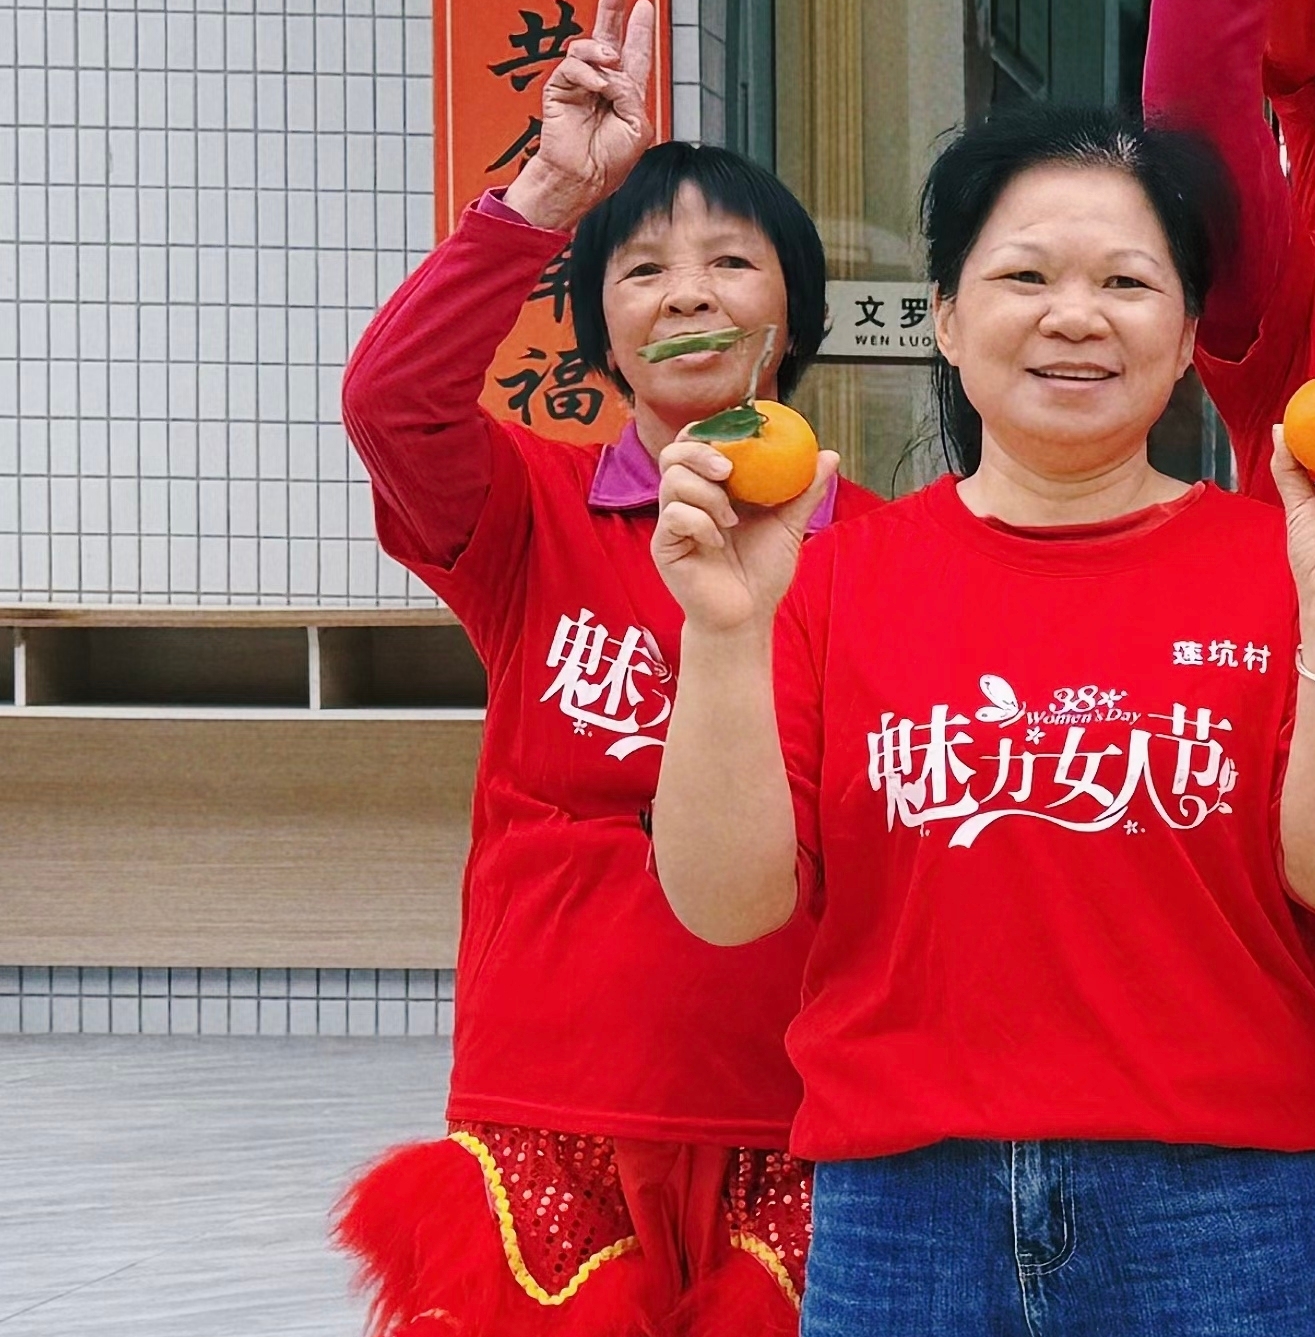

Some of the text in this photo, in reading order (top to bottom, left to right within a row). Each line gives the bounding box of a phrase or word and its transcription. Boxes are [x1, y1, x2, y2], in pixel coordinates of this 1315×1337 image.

[854, 295, 928, 329] 文罗
[854, 335, 932, 348] WEN LUO
[539, 607, 672, 734] 魅
[1048, 684, 1099, 715] 38
[866, 702, 1238, 834] 魅力女人节
